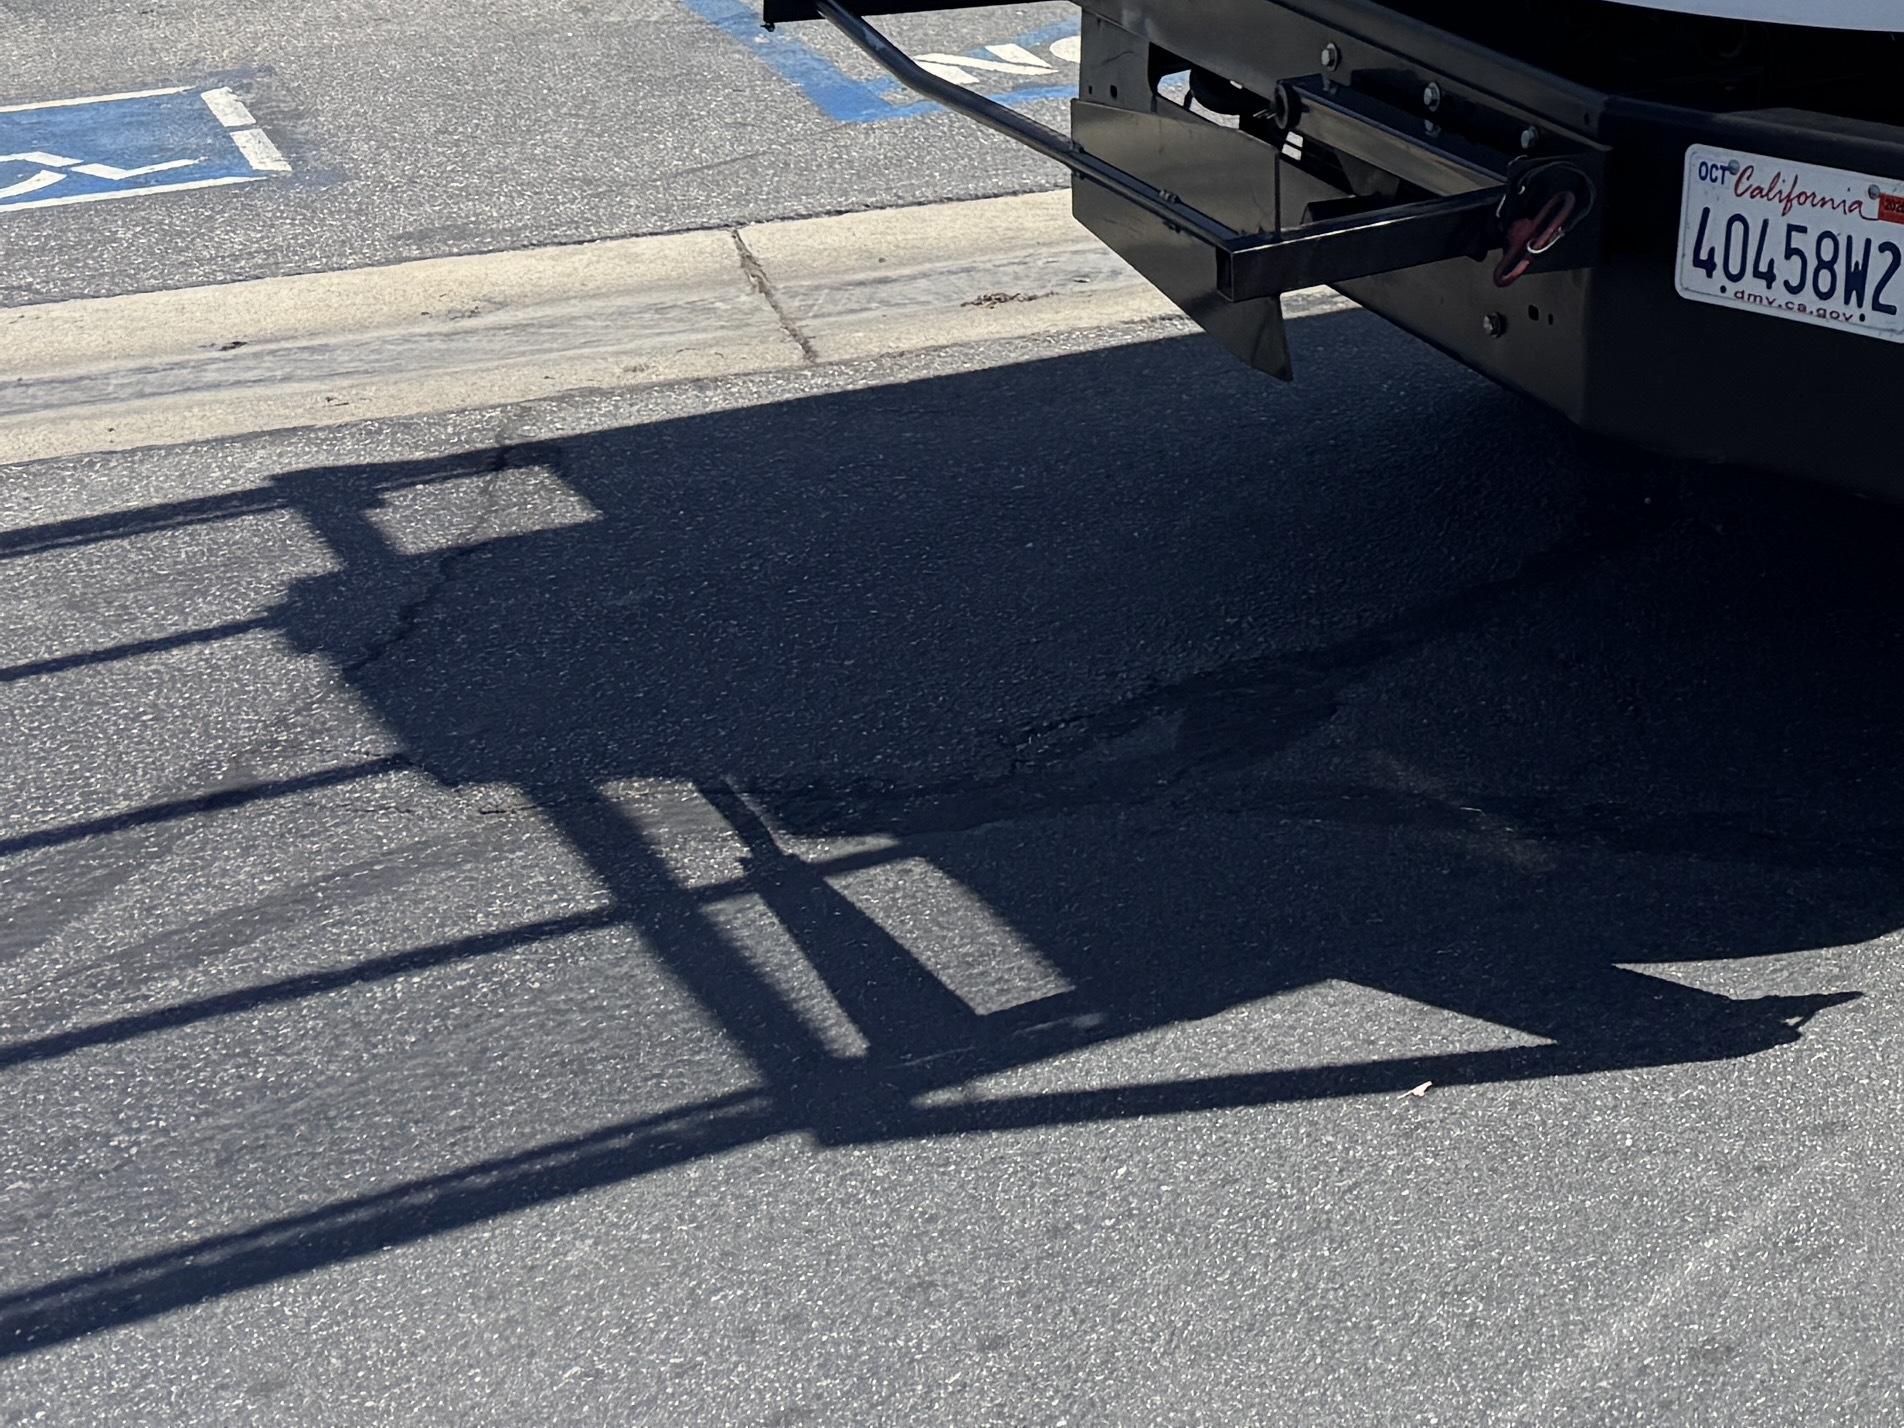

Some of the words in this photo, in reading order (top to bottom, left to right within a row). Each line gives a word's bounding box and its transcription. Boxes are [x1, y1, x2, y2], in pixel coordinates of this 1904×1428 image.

[1698, 160, 1728, 186] OCT
[1734, 165, 1878, 221] California
[1692, 206, 1903, 316] 40458W2
[1733, 289, 1854, 323] dmv.ca.gov
